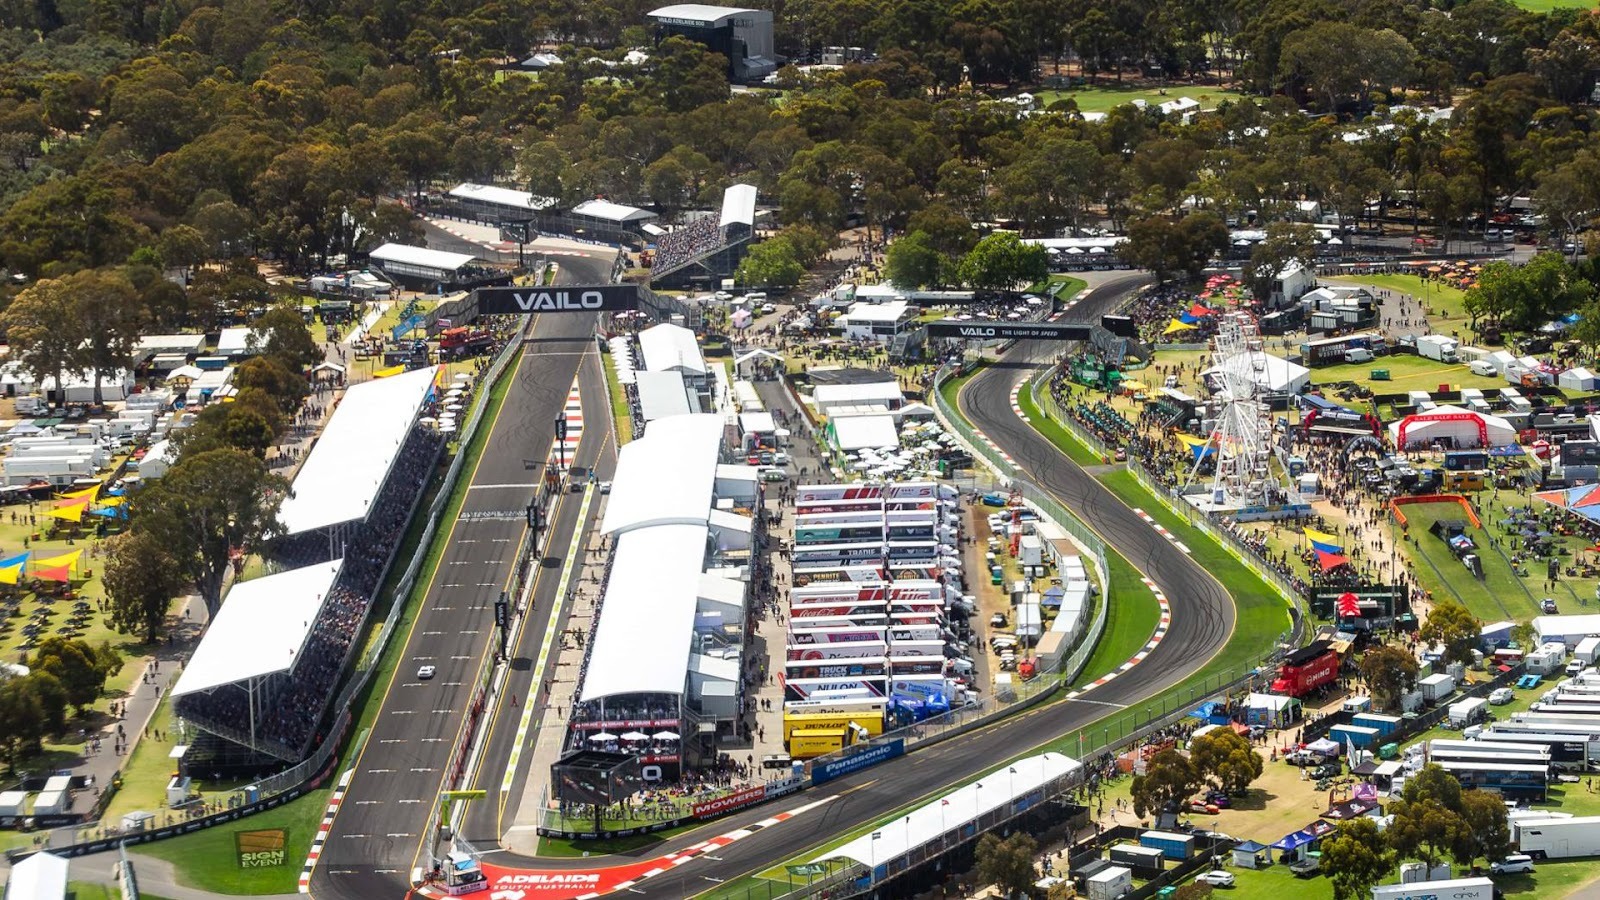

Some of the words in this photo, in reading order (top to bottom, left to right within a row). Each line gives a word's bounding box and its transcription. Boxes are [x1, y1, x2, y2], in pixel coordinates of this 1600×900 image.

[513, 291, 603, 310] VAILO
[960, 327, 995, 336] VAILO
[826, 744, 892, 773] Panasonic
[642, 765, 662, 781] Q
[695, 790, 764, 813] MOWERS
[765, 777, 801, 793] PLUS
[700, 809, 724, 820] TRUST
[725, 804, 746, 814] YOUR
[242, 851, 284, 860] SIGN
[242, 859, 282, 867] EVENT
[496, 874, 600, 884] ADELAIDE
